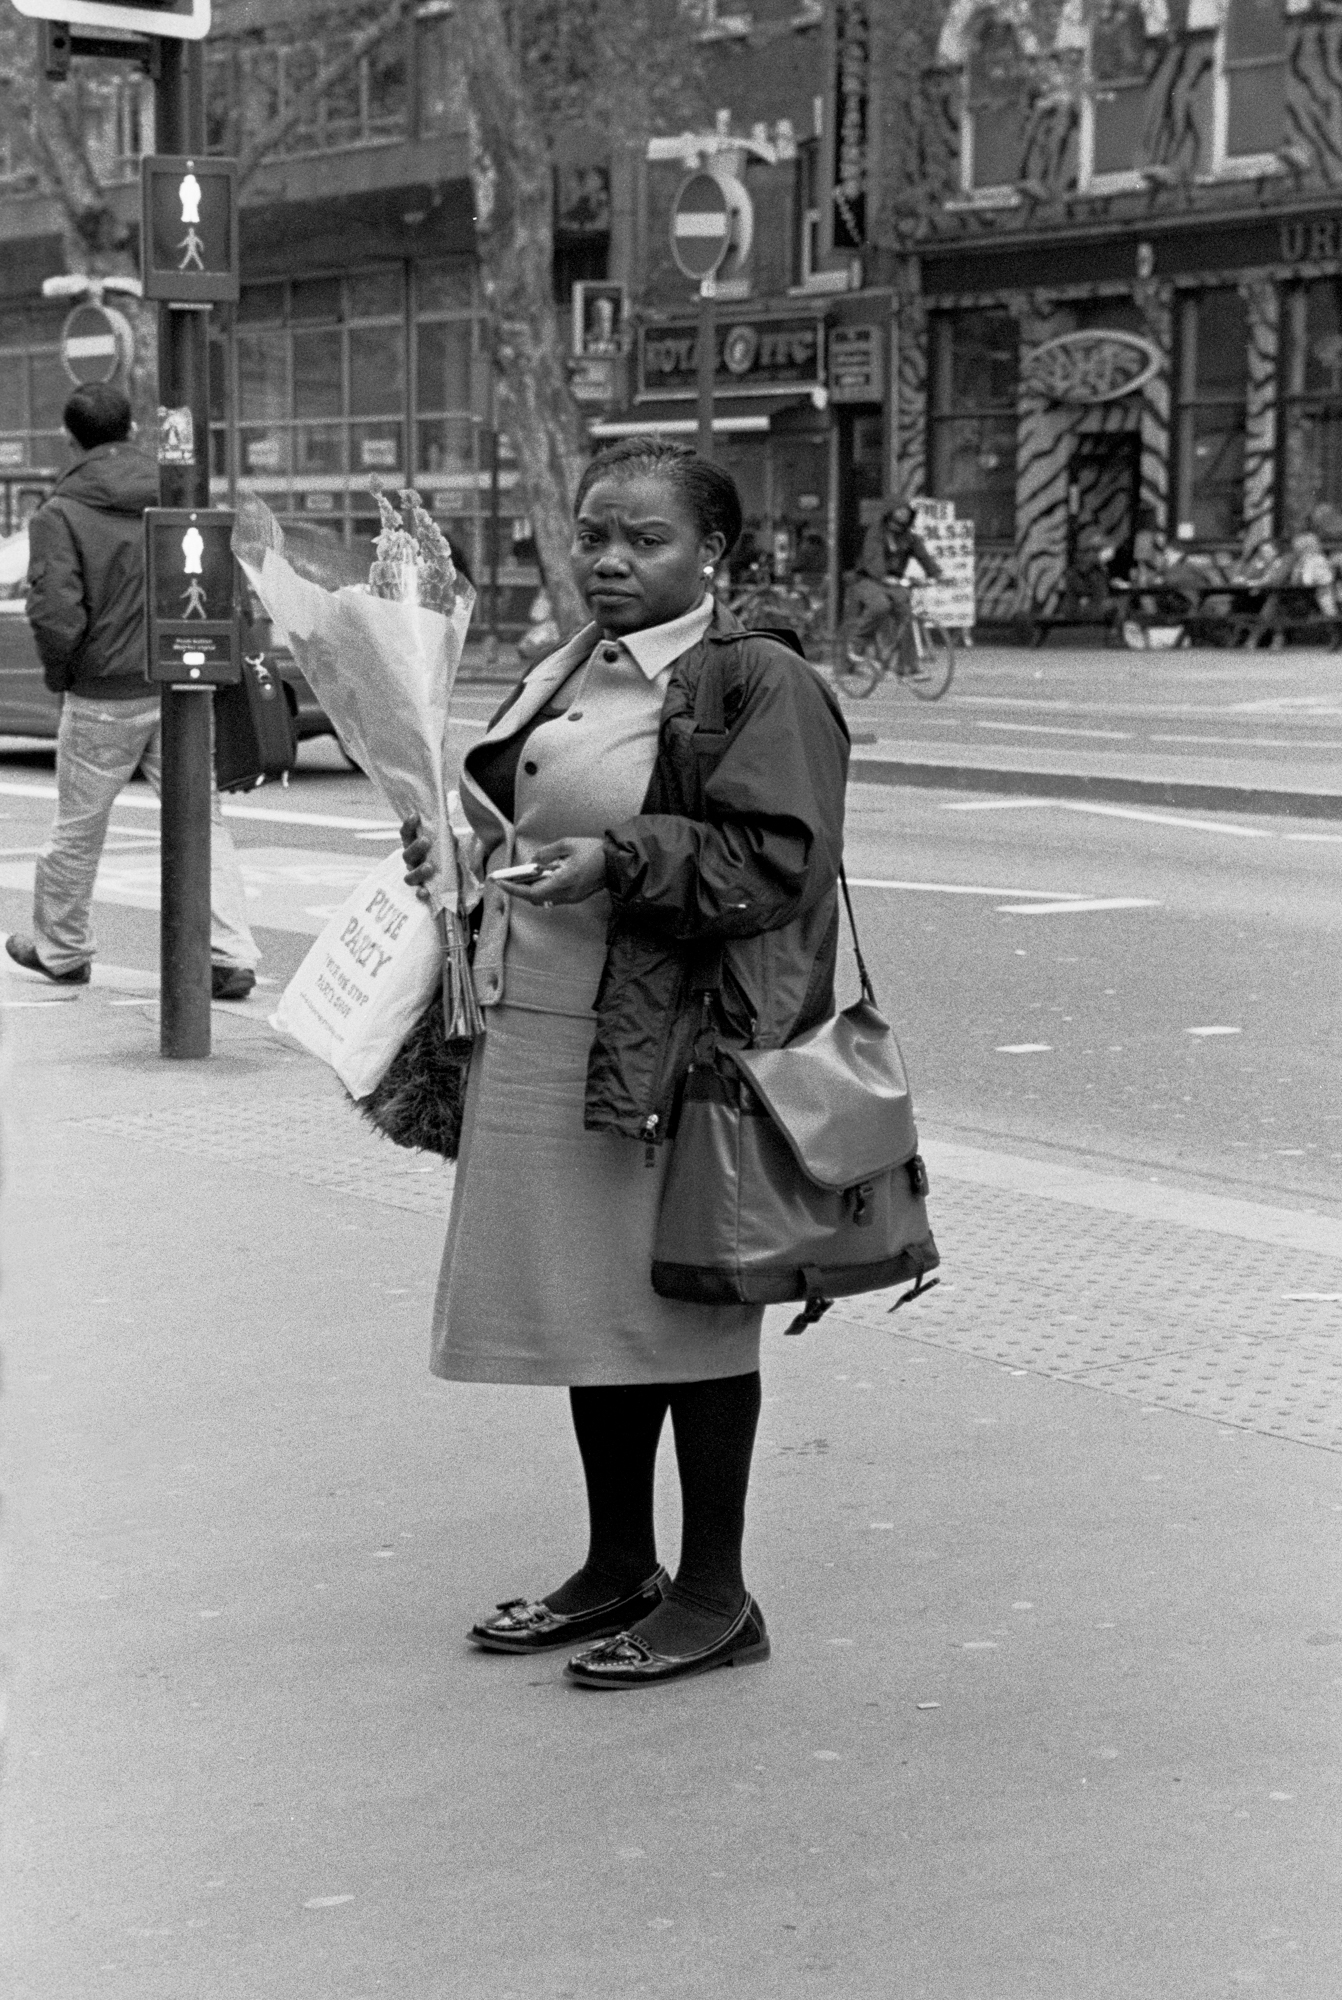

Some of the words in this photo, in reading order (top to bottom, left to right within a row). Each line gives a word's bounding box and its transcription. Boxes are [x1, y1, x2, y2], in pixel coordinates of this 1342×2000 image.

[1280, 220, 1342, 262] UR
[339, 916, 392, 978] PARTY
[347, 983, 369, 1007] STOP
